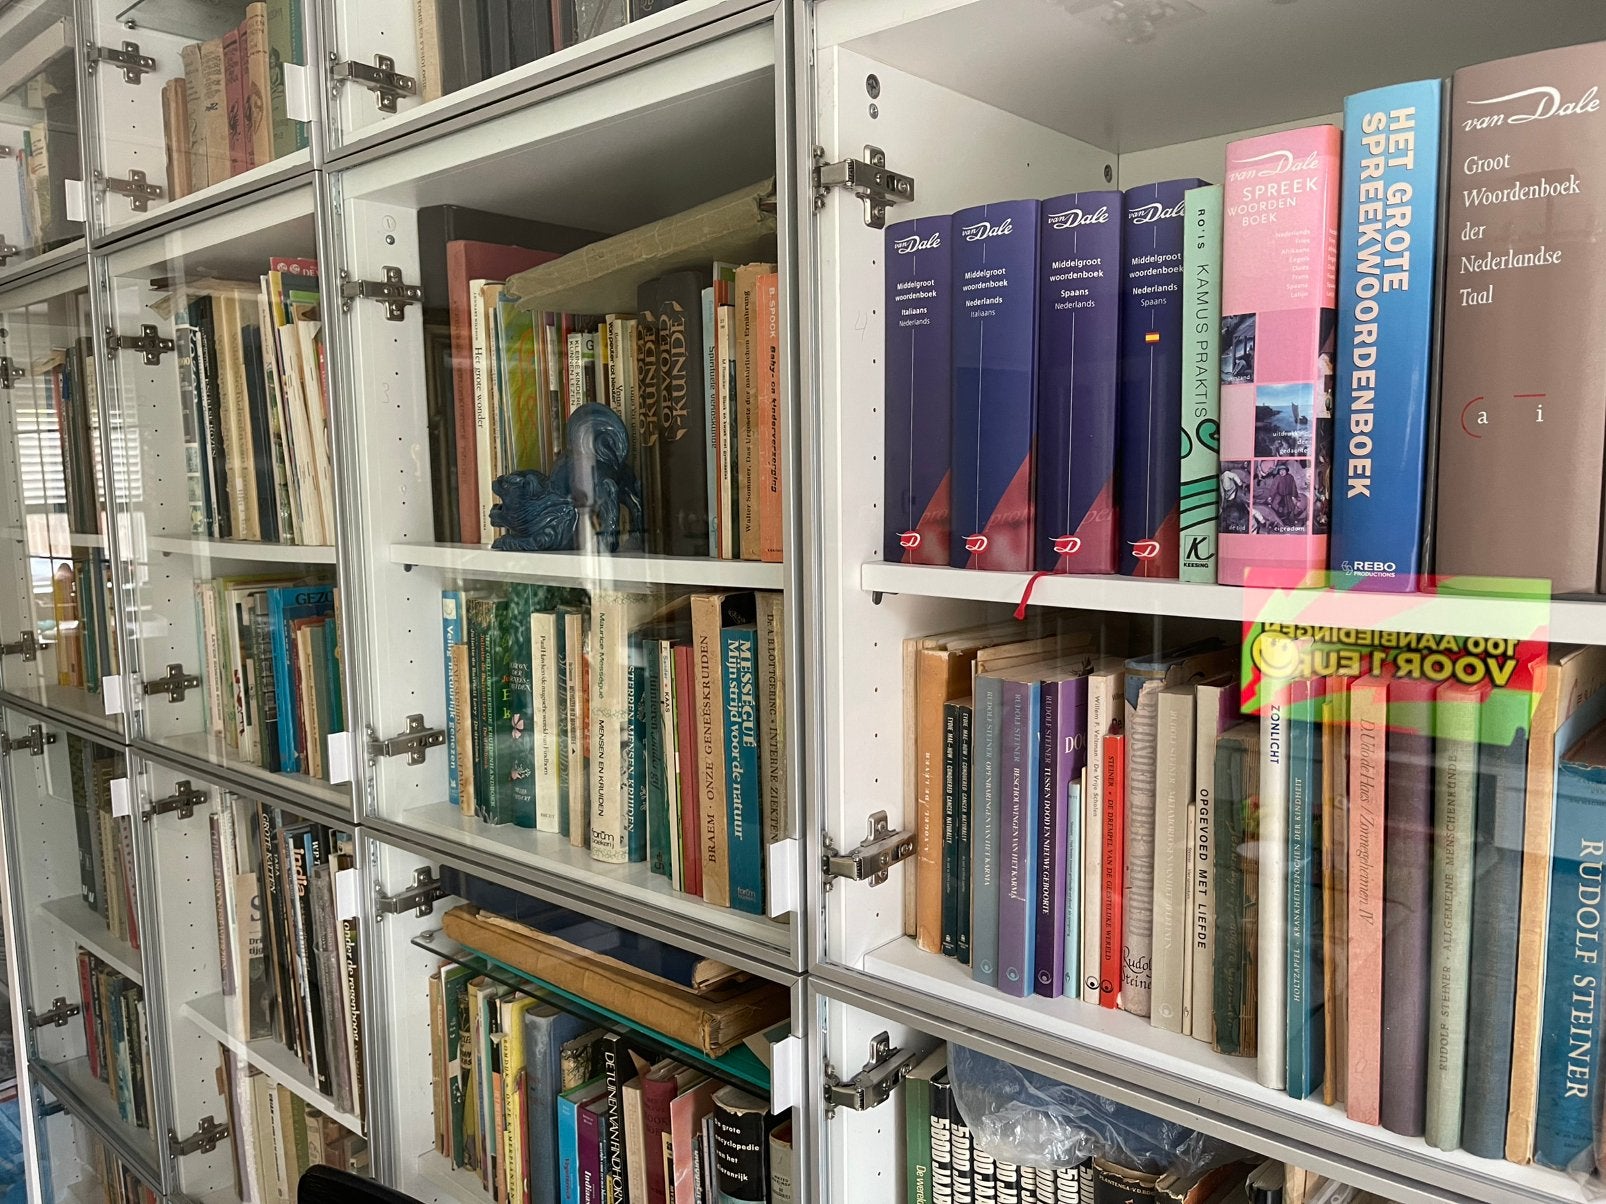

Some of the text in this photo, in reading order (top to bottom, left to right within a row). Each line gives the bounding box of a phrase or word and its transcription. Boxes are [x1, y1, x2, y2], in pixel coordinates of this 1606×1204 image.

[1462, 86, 1601, 132] van Dale
[1229, 170, 1257, 183] van
[1462, 153, 1511, 176] Groot
[1242, 177, 1318, 201] SPREEK
[1383, 106, 1416, 292] HET GROTE
[1461, 174, 1581, 208] Woordenboek
[1048, 206, 1109, 229] Dale
[1227, 197, 1297, 216] WOORDEN
[962, 218, 1013, 241] Dale
[1241, 212, 1278, 227] BOEK
[1460, 221, 1487, 242] der
[895, 233, 941, 254] Dale
[1052, 258, 1102, 269] Middelgroot
[1131, 253, 1182, 265] Middelgroot
[1459, 245, 1563, 274] Nederlandse
[964, 268, 1006, 279] Middelgroot
[1050, 269, 1104, 281] woordenboek
[1129, 265, 1185, 278] woordenboek
[895, 290, 938, 302] woordenboek
[897, 280, 935, 290] Middelgroot
[962, 279, 1008, 291] woordenboek
[1060, 289, 1089, 298] Spaans
[1133, 283, 1178, 295] Nederlands
[1459, 284, 1494, 306] Taal
[901, 307, 927, 316] Italiaans
[965, 296, 1003, 307] Nederlands
[1054, 299, 1100, 310] Nederlands
[1140, 297, 1167, 307] Spaans
[1195, 264, 1210, 335] KAMUS
[1347, 111, 1386, 500] SPREEKWOORDENBOEK
[899, 318, 930, 327] Nederlands
[970, 309, 996, 318] Italiaans
[574, 339, 582, 370] KLEINE
[608, 336, 617, 362] peuter
[472, 347, 486, 429] Het grote wonder
[1194, 340, 1209, 419] PRAKTIS
[1477, 405, 1544, 424] a i
[1353, 560, 1396, 572] REBO
[1353, 570, 1396, 578] PRODUCTIONS
[446, 625, 457, 769] Veilig natuurlijk genezen
[738, 639, 757, 749] MESSÉGUÉ
[1094, 695, 1102, 720] Willem
[699, 629, 718, 864] BRAEM ONZE GENEESKRUIDEN
[725, 639, 744, 841] Mijn strijd voor de natuur
[1093, 729, 1102, 757] Veltman
[1270, 704, 1281, 765] ZONLICHT
[1360, 732, 1376, 758] Udo
[626, 665, 635, 833] STERREN MENSEN KRUIDEN
[598, 761, 605, 775] EN
[1093, 763, 1101, 773] De
[1360, 758, 1375, 772] de
[769, 726, 779, 841] INTERNE ZIEKTEN
[984, 761, 992, 823] OPENBARINGEN
[1092, 774, 1101, 791] Vrije
[1010, 695, 1022, 899] RUDOLF STEINER BESCHOUWINGEN VAN HET KARMA
[1042, 696, 1053, 915] RUDOLF STEINER TUSSEN DOOD EN NIEUWE GEBOORTE
[1093, 792, 1101, 817] Scholen
[1107, 799, 1115, 810] DE
[1294, 776, 1302, 821] KINDHEIT
[960, 815, 968, 842] NATURALLY
[1107, 811, 1115, 847] DREMPEL
[262, 813, 276, 894] GROTE KATTEN
[1106, 849, 1114, 866] VAN
[1355, 813, 1375, 905] Zonnegeheimen
[293, 847, 308, 898] india
[1106, 867, 1114, 880] DE
[1197, 788, 1209, 950] OPGEVOED MET LIEFDE
[1293, 843, 1301, 937] KRANKHEITSEPOCHEN
[1575, 837, 1605, 964] RUDOLF
[1105, 880, 1114, 928] GEESTELIJKE
[1439, 754, 1457, 1072] RUDOLF STEINER ALLGEMEINE MENSCHENKUNDE
[1105, 929, 1114, 961] WERELD
[344, 921, 361, 1042] onder de regenboog
[1564, 974, 1598, 1099] STEINER
[604, 1051, 624, 1204] DE TUINEN VAN FINDHORN
[722, 1124, 741, 1135] grote
[726, 1154, 739, 1164] het
[916, 1164, 927, 1175] De
[717, 1163, 749, 1182] dierenrijk
